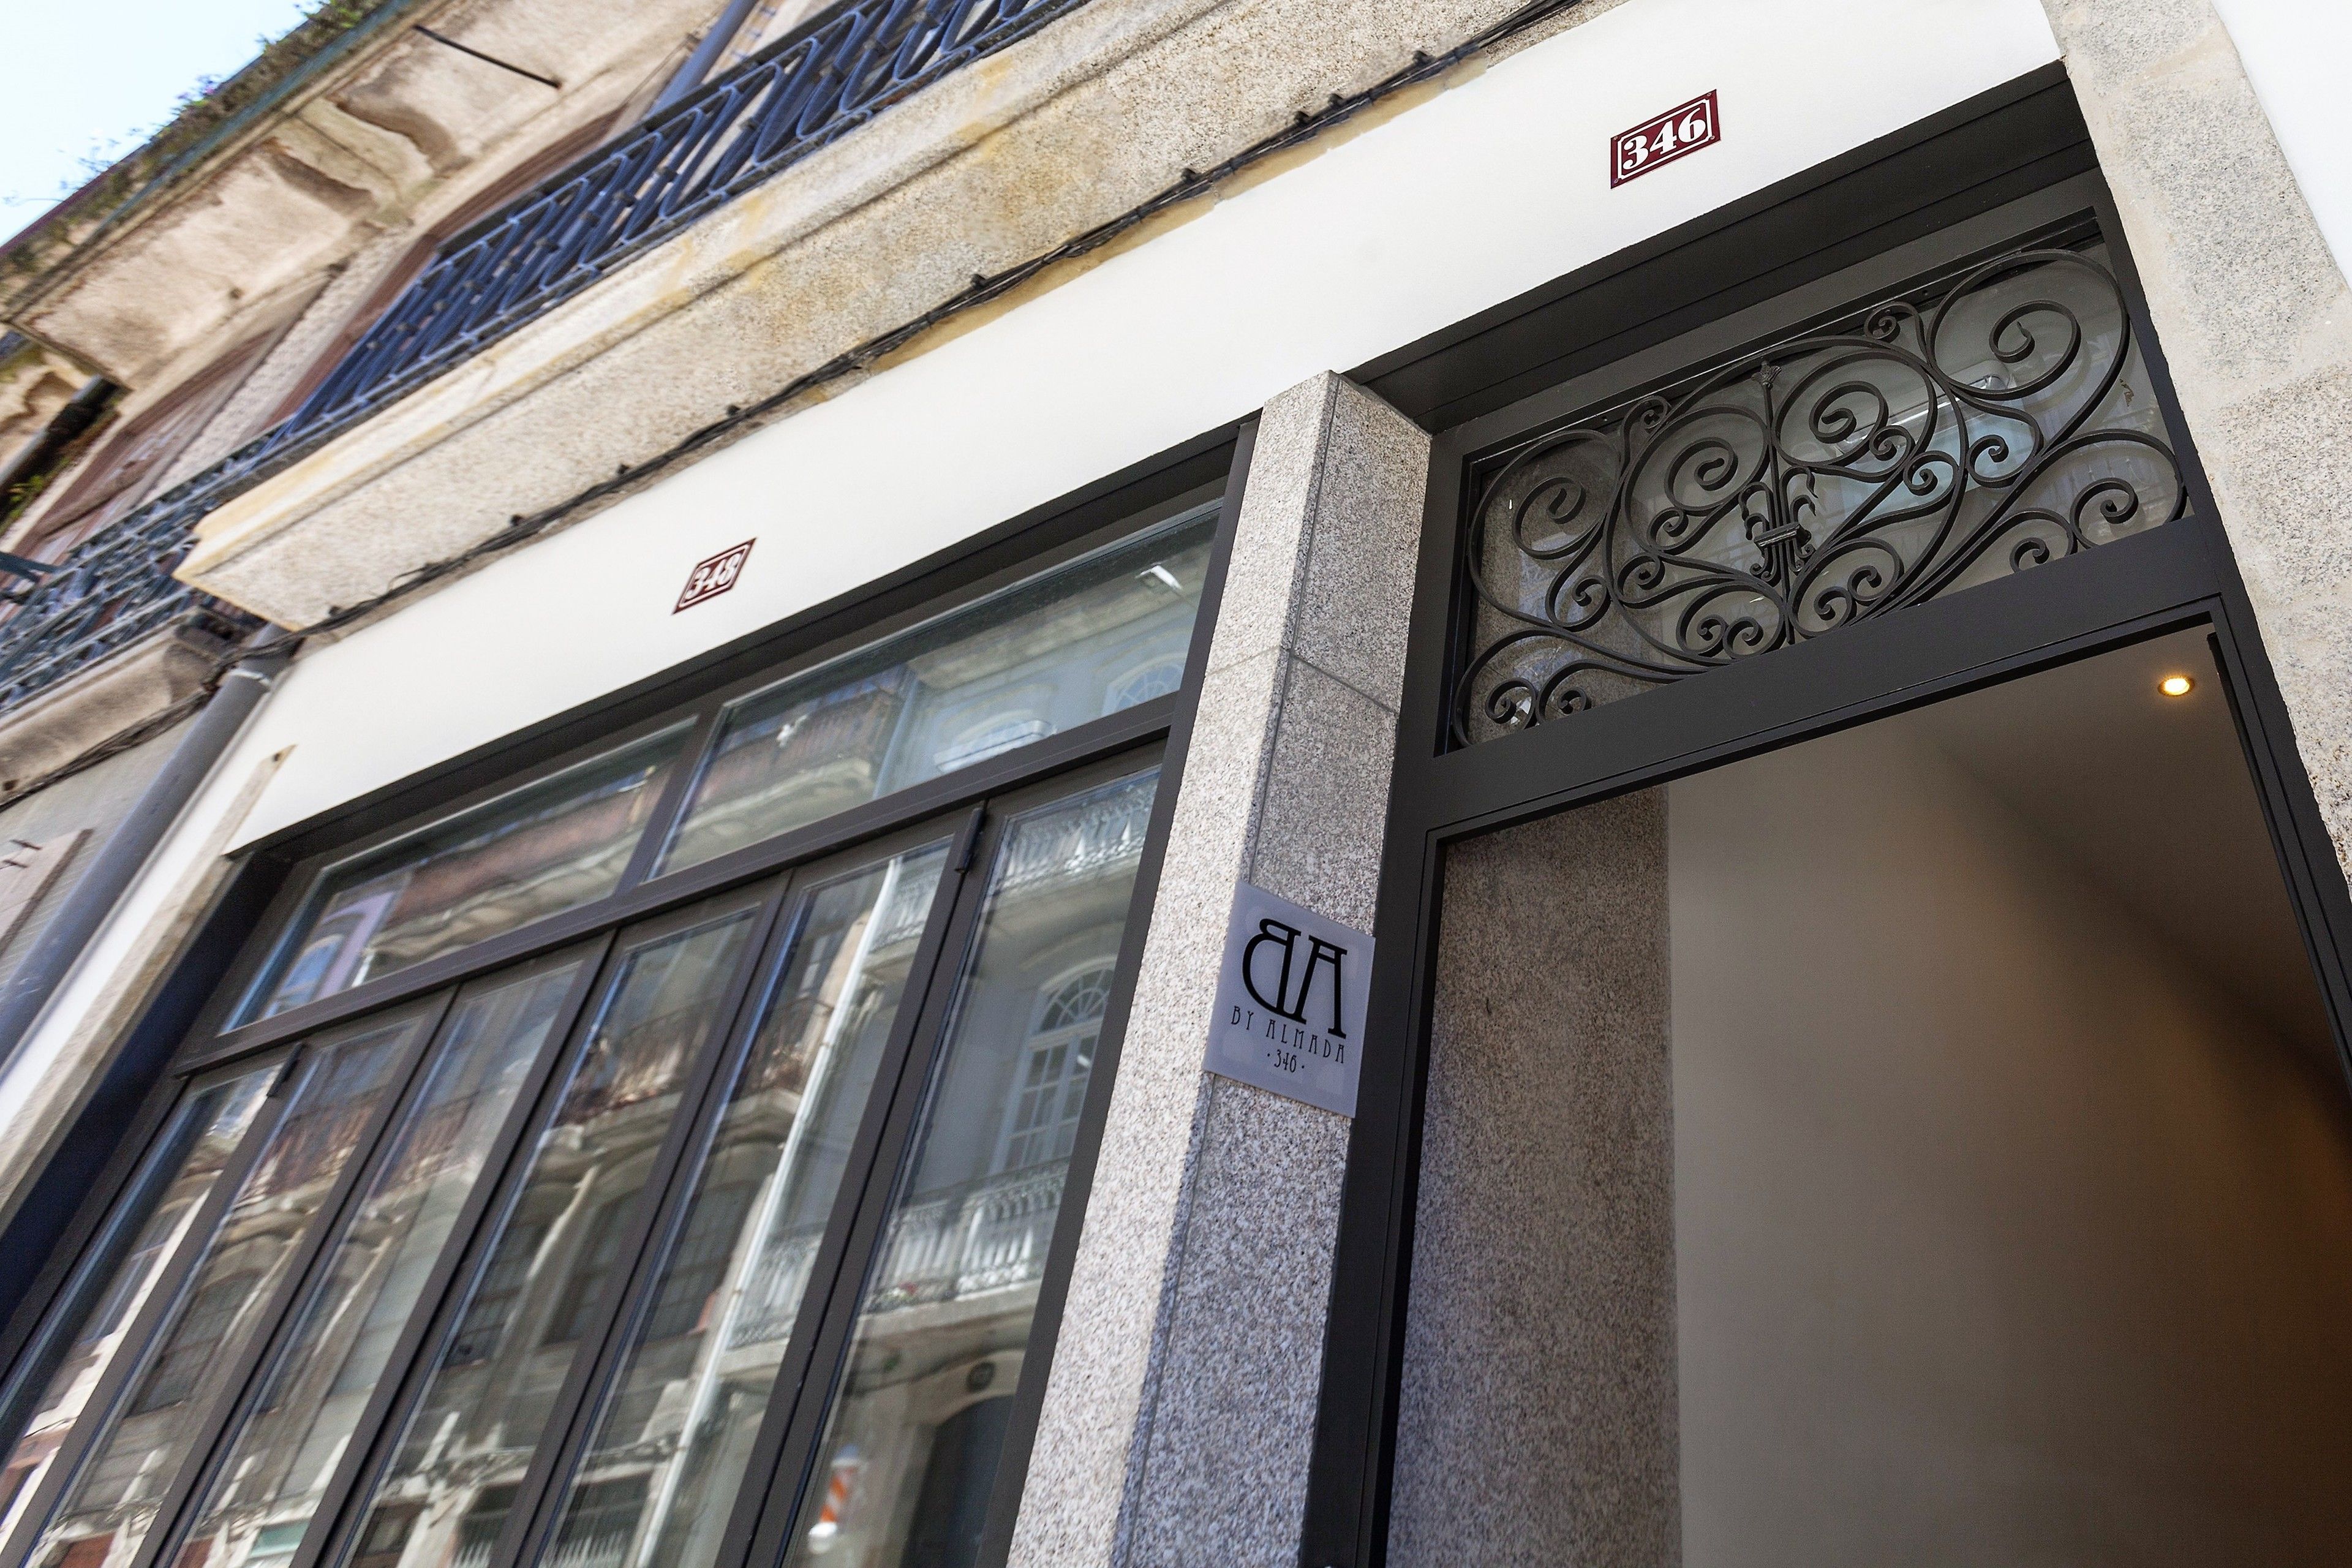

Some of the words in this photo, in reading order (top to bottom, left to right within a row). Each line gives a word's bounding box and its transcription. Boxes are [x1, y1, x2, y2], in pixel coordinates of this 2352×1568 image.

[1623, 107, 1706, 170] 346
[684, 552, 742, 600] 348
[1231, 1005, 1254, 1030] BY
[1265, 1019, 1345, 1064] ALMADA
